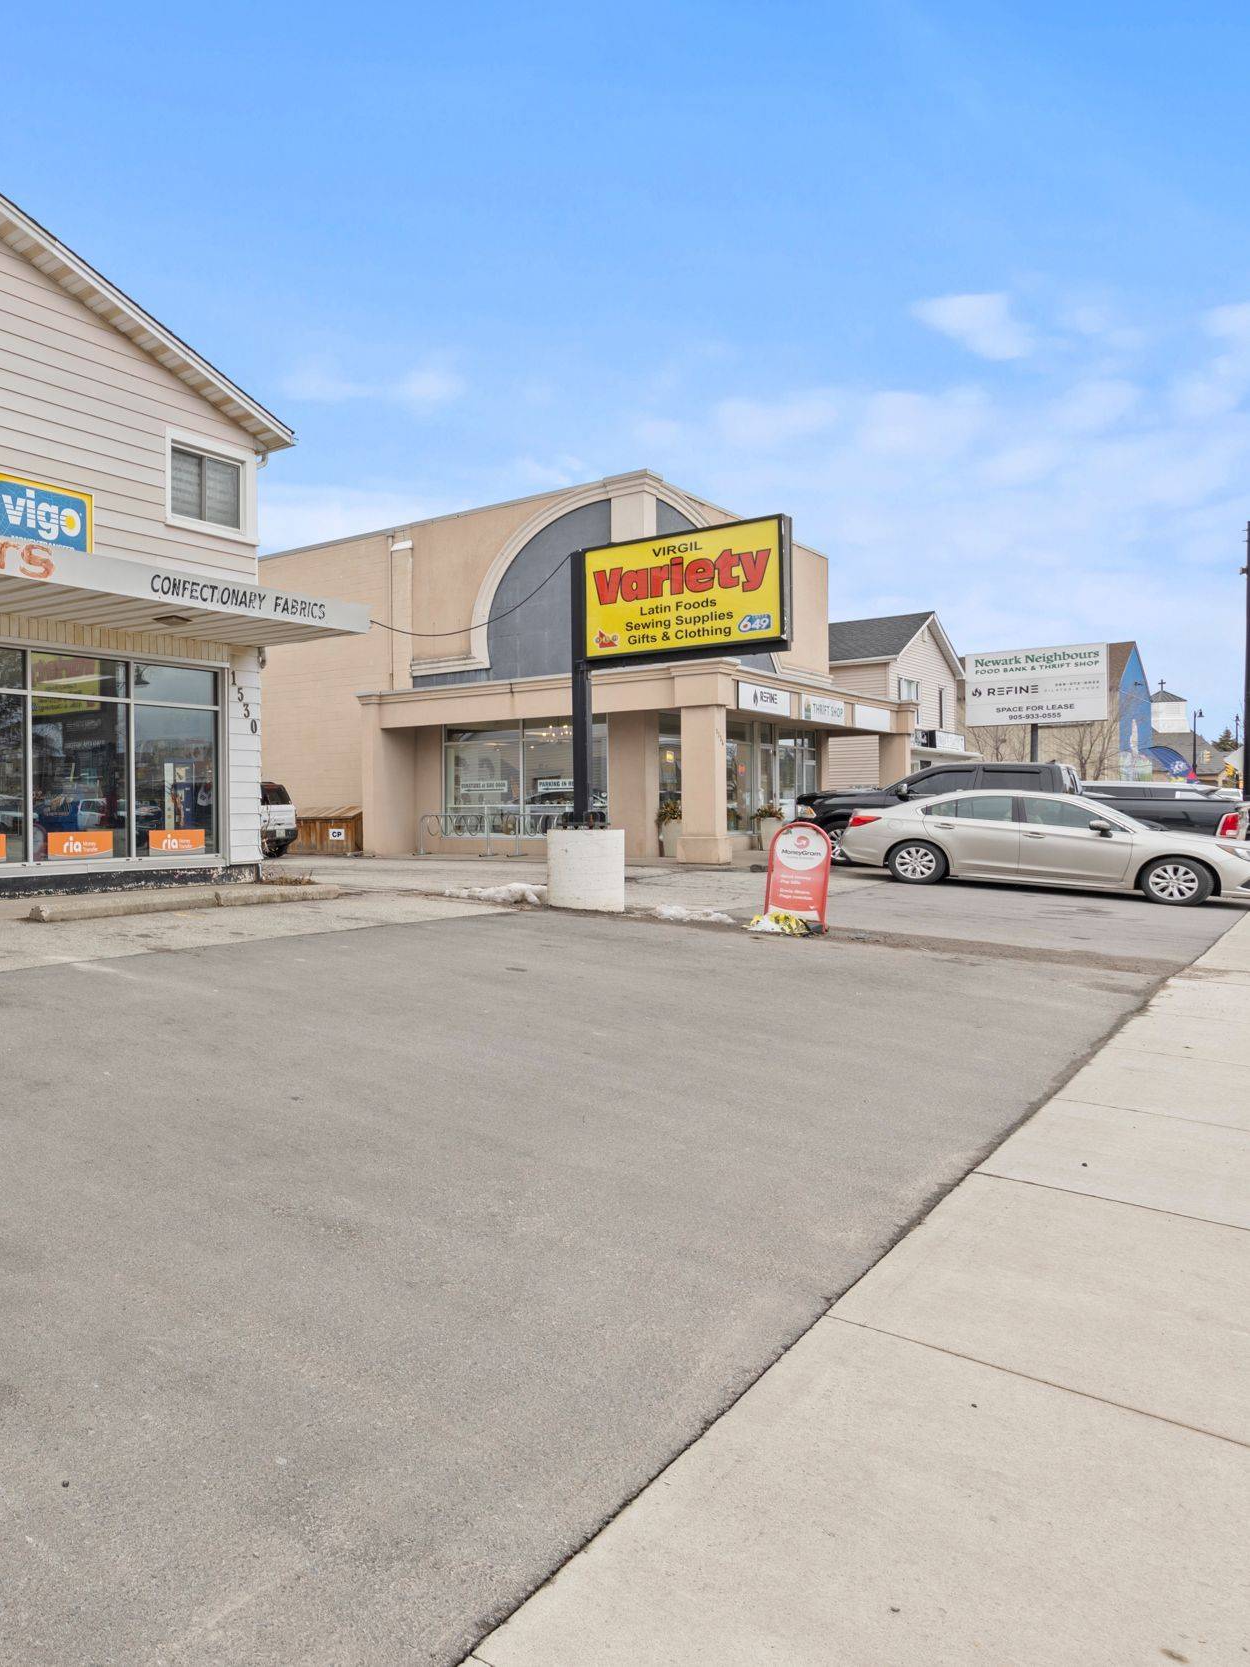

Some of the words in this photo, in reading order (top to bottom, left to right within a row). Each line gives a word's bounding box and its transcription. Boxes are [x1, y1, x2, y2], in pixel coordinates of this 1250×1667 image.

[1, 488, 82, 539] vigo
[652, 541, 703, 558] VIRGIL
[593, 548, 772, 606] Variety
[150, 574, 267, 610] CONFECTIONARY
[273, 596, 326, 619] FABRICS
[640, 604, 671, 616] Latin
[675, 597, 717, 611] Foods
[625, 615, 672, 632] Sewing
[675, 610, 734, 627] Supplies
[627, 632, 657, 646] Gifts
[661, 631, 670, 642] &
[675, 624, 732, 640] Clothing
[974, 656, 1022, 667] Newark
[1025, 650, 1100, 664] Neighbours
[1039, 662, 1070, 671] THRIFT
[759, 691, 778, 705] REFINE
[987, 685, 1039, 697] REFINE
[812, 703, 830, 715] THRIFT
[831, 706, 844, 717] SHOP
[63, 835, 82, 853] ria
[162, 833, 178, 850] ria
[781, 848, 822, 857] MoneyGram
